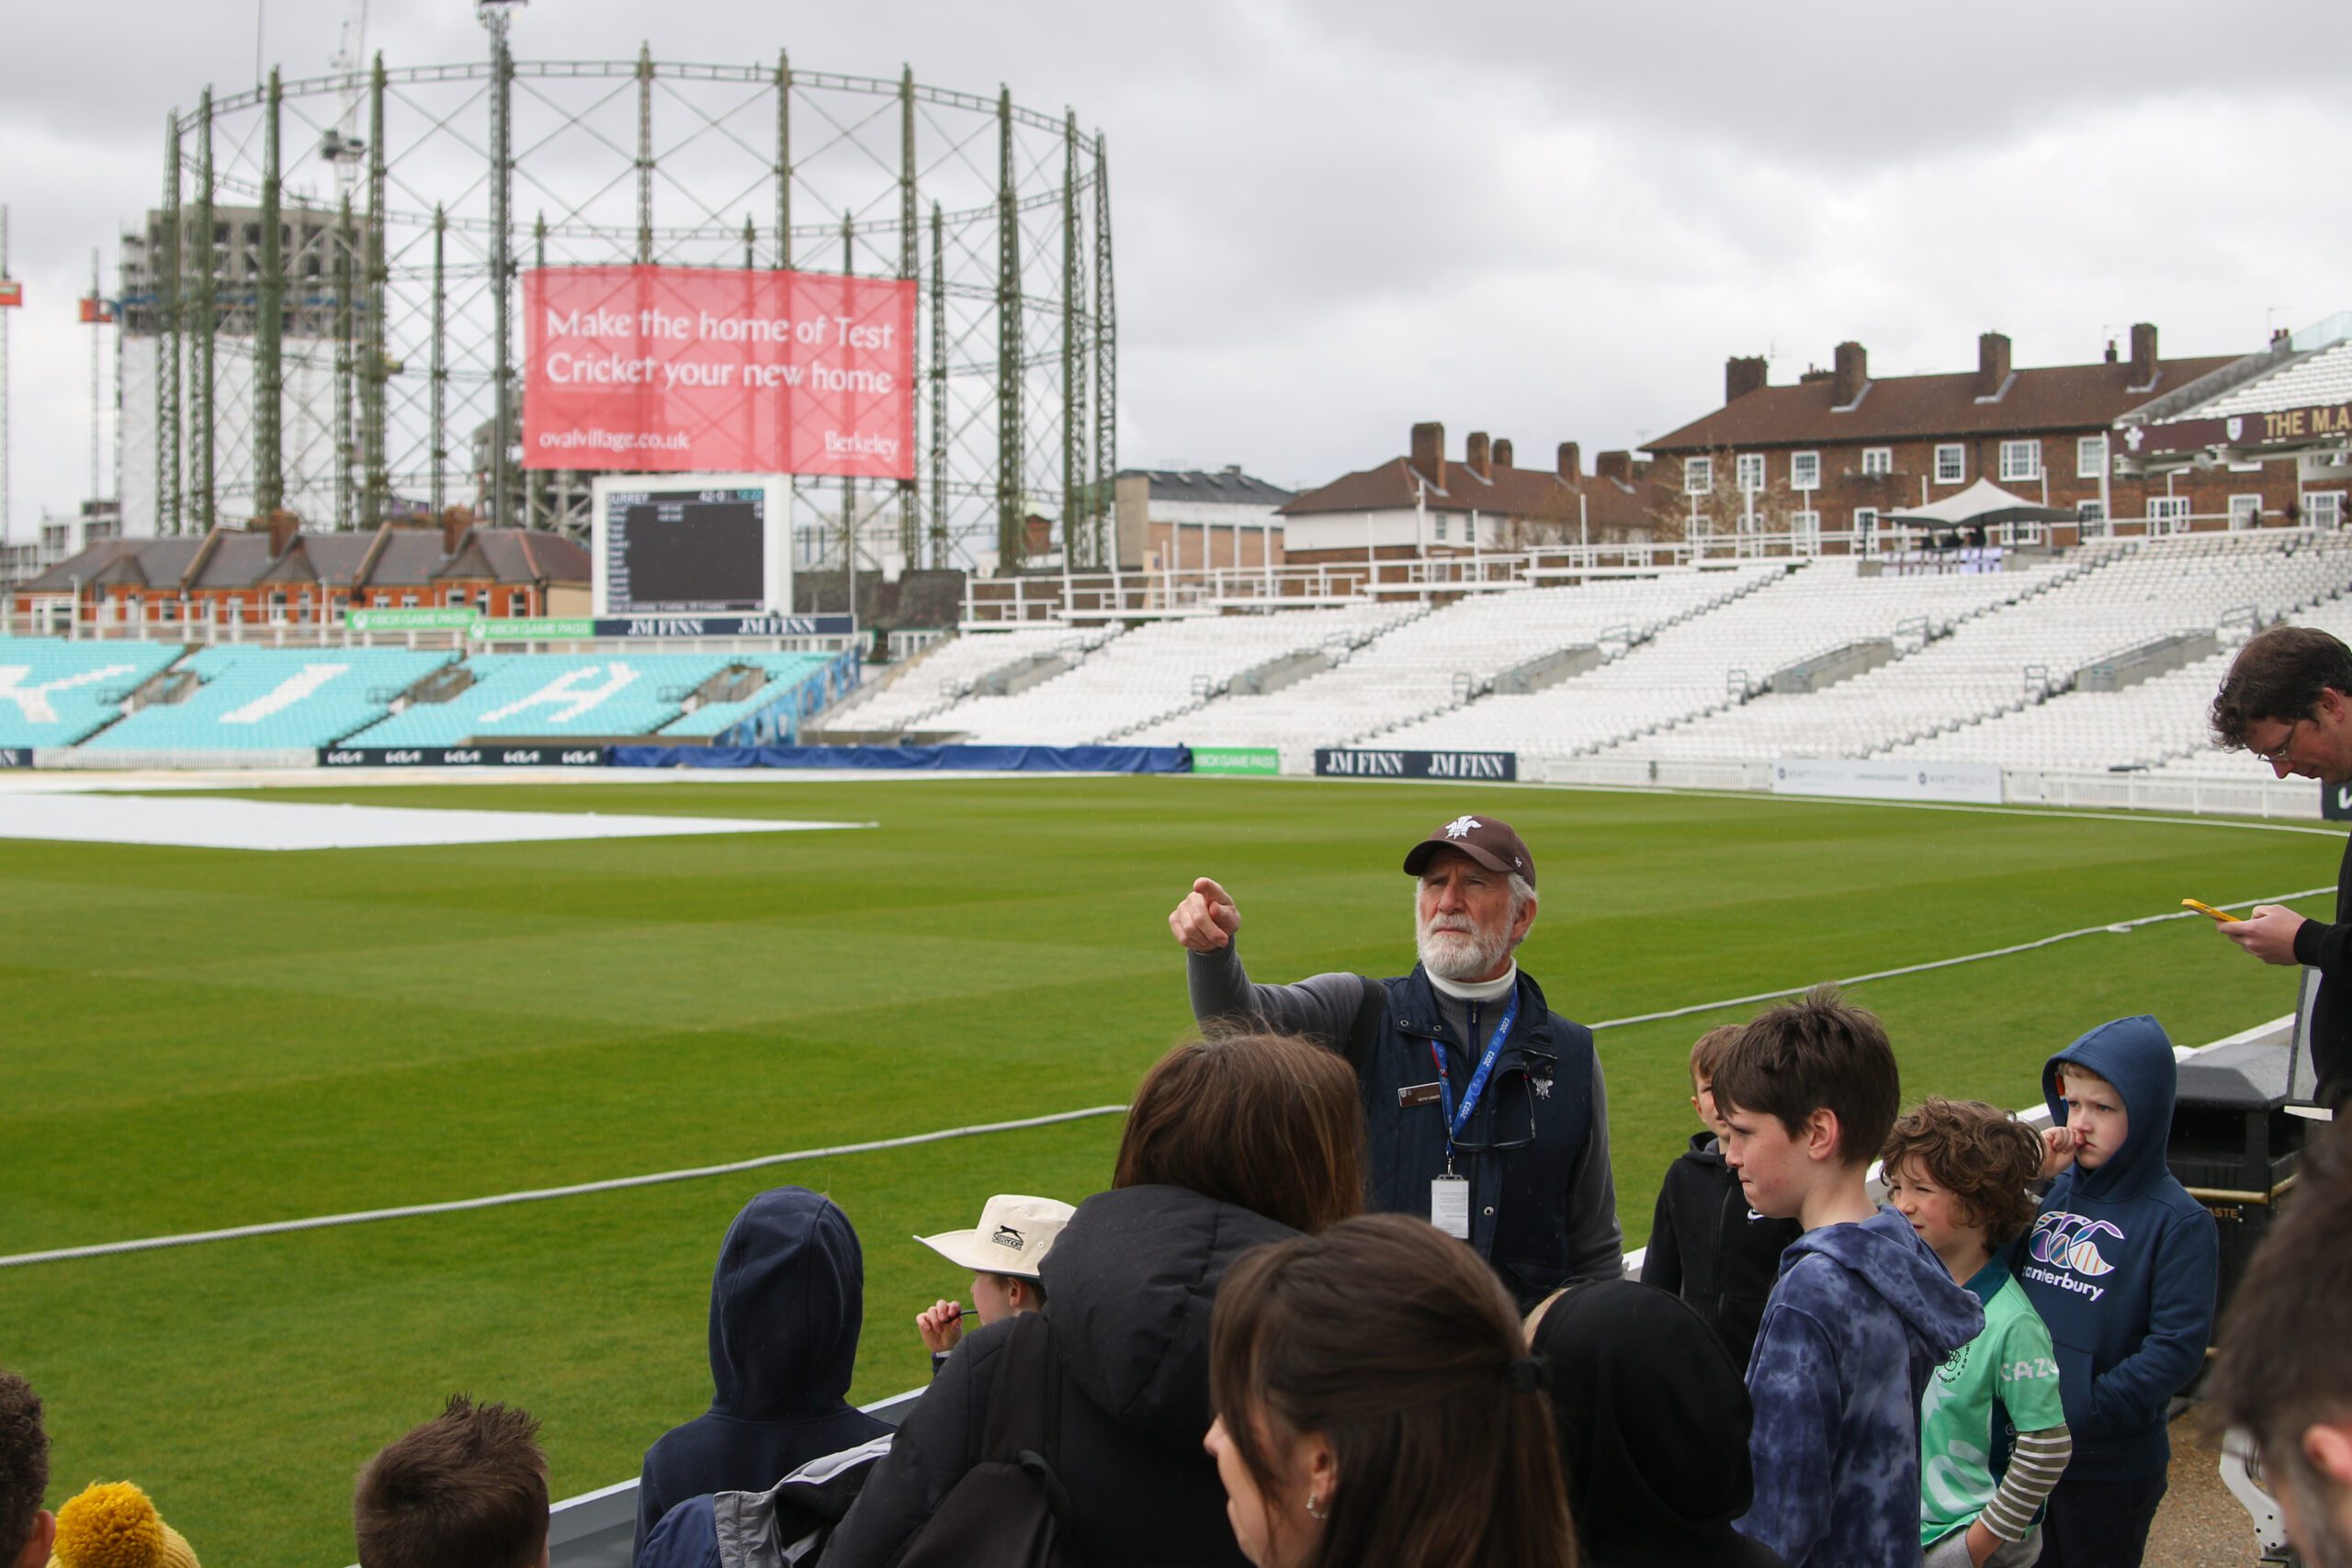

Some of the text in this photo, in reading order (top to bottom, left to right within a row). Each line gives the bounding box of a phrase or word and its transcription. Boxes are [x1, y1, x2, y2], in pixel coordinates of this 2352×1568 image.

[546, 308, 894, 350] Make the home of Test
[546, 352, 892, 393] Cricket your new home
[2264, 411, 2305, 436] THE
[538, 429, 691, 451] ovalvillage.co.uk
[825, 431, 899, 460] Berkeley
[370, 613, 469, 626] XBOX GAME PASS
[628, 618, 816, 635] JM FINN JM FINN
[488, 623, 589, 636] XBOX GAME PASS
[1219, 754, 1250, 767] GAME
[1250, 755, 1276, 768] PASS
[1326, 751, 1505, 777] JM FINN JM FINN
[1499, 1017, 1510, 1033] 2023
[1483, 1051, 1495, 1067] 2023
[1460, 1101, 1472, 1119] 2023
[1935, 1370, 1956, 1383] LONDON
